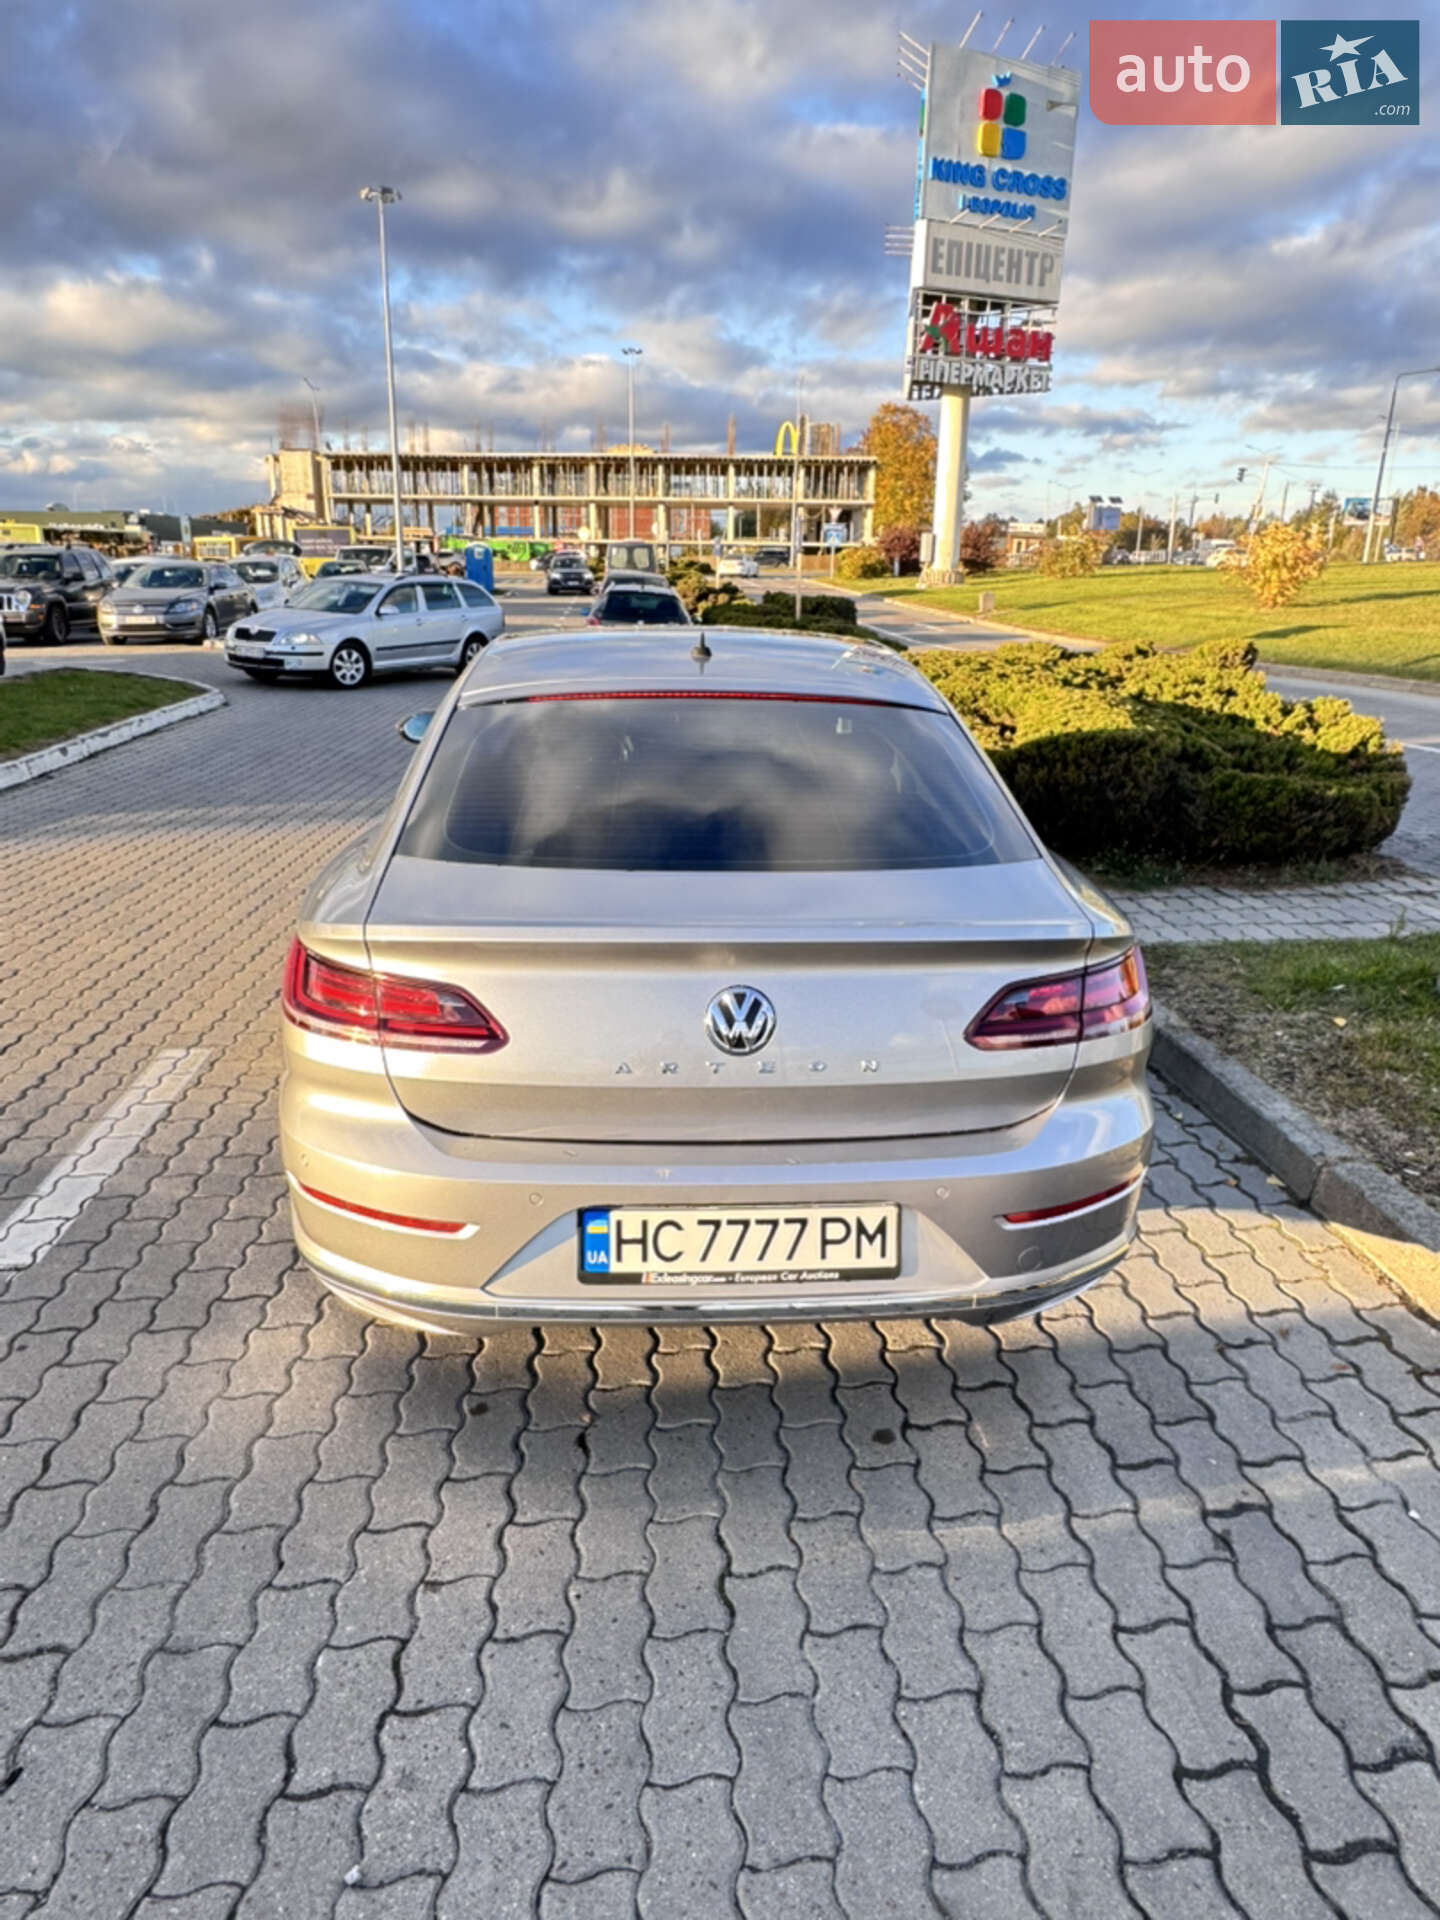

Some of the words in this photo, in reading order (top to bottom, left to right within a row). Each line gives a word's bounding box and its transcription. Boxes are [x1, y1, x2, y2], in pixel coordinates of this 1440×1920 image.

[930, 157, 987, 188] KING
[992, 167, 1068, 201] CROSS
[931, 237, 1054, 288] ЕПІЦЕНТР
[615, 1060, 880, 1074] ARTEON
[587, 1251, 609, 1265] UA
[615, 1219, 684, 1263] HC
[696, 1217, 809, 1262] 7777
[820, 1215, 888, 1260] PM
